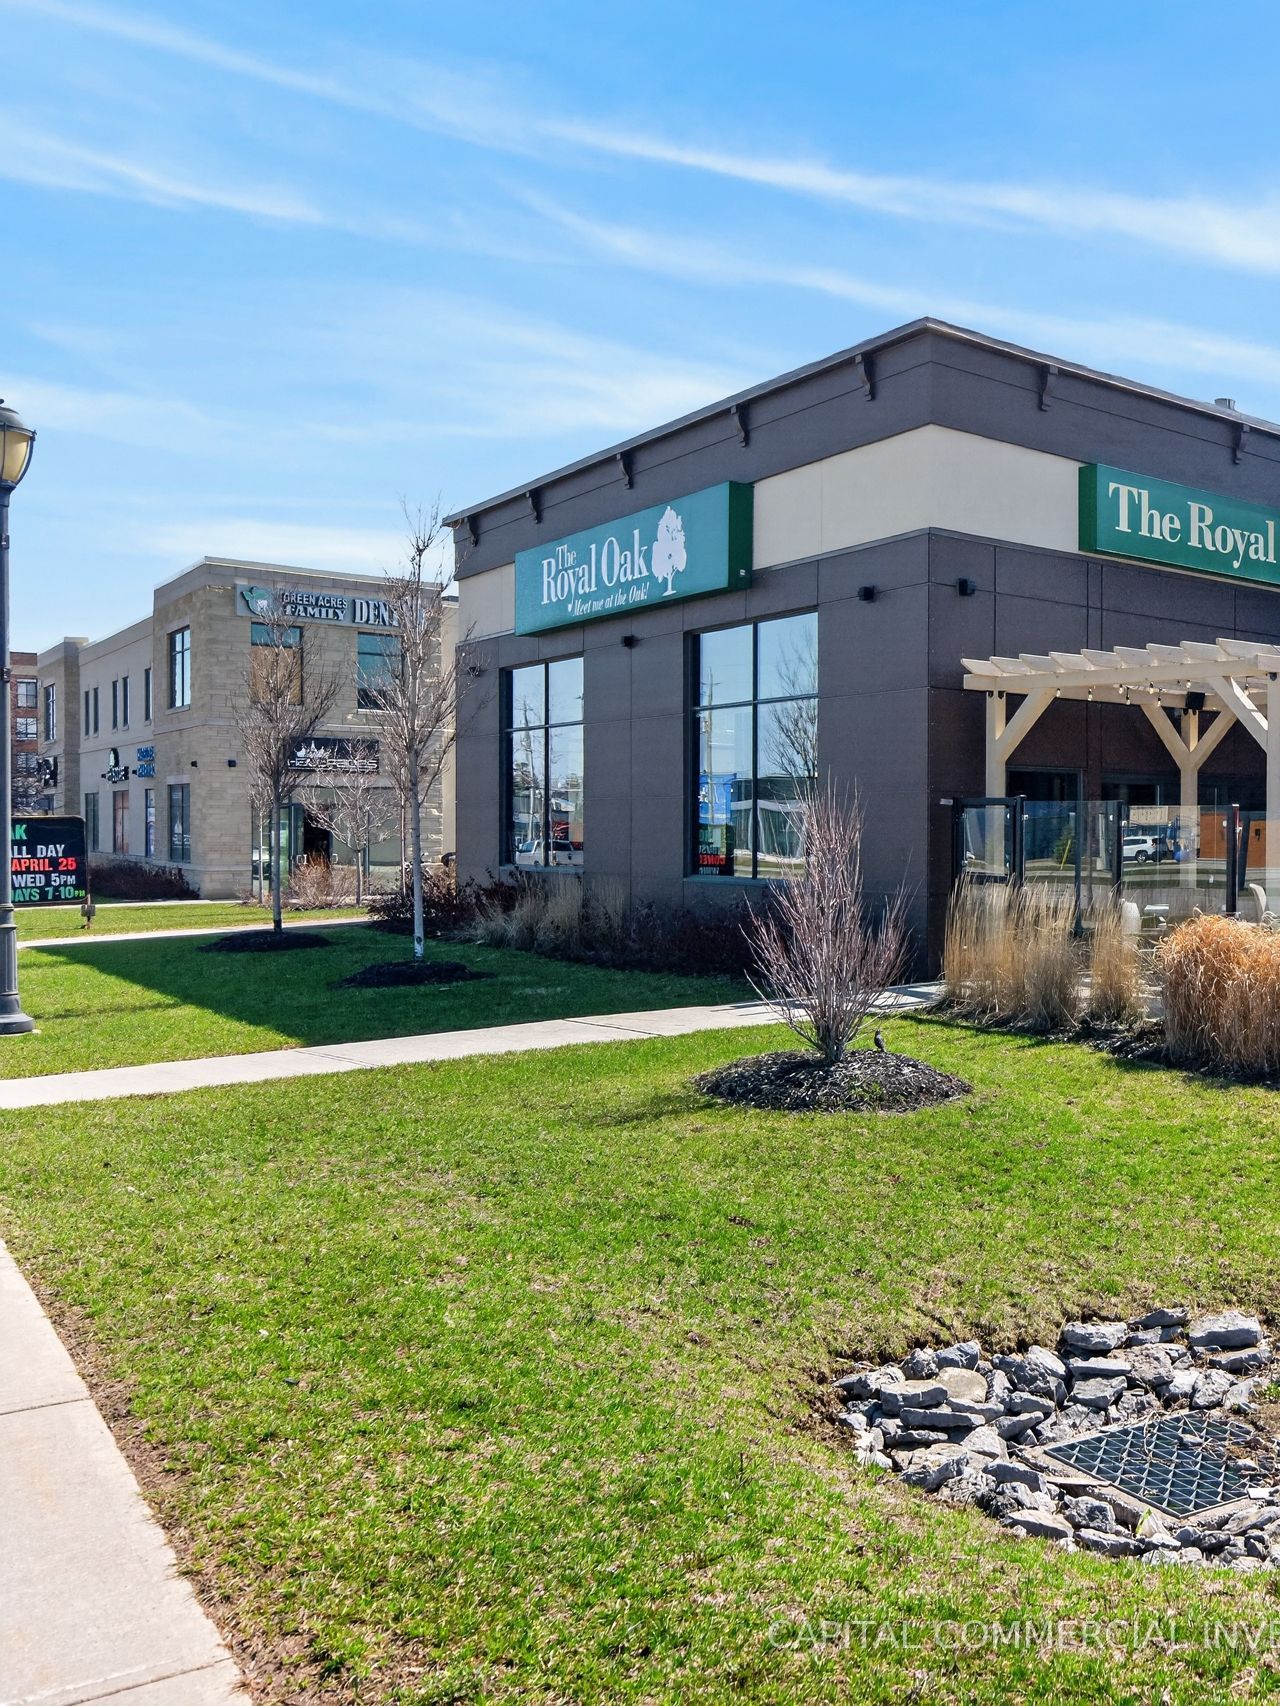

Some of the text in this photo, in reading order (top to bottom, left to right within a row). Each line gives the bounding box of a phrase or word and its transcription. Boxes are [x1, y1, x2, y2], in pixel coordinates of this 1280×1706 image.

[1108, 482, 1181, 543] The
[1187, 501, 1277, 569] Royal
[556, 544, 577, 569] The
[541, 528, 649, 612] Royal Oak
[318, 595, 348, 609] ACRES
[573, 599, 591, 616] Meet
[614, 588, 627, 606] the
[629, 581, 650, 603] Oak!
[284, 603, 346, 621] FAMILY
[354, 599, 400, 627] DEN
[11, 844, 65, 858] LL DAY
[11, 857, 77, 872] APRIL 25
[12, 872, 76, 888] WED 5PM
